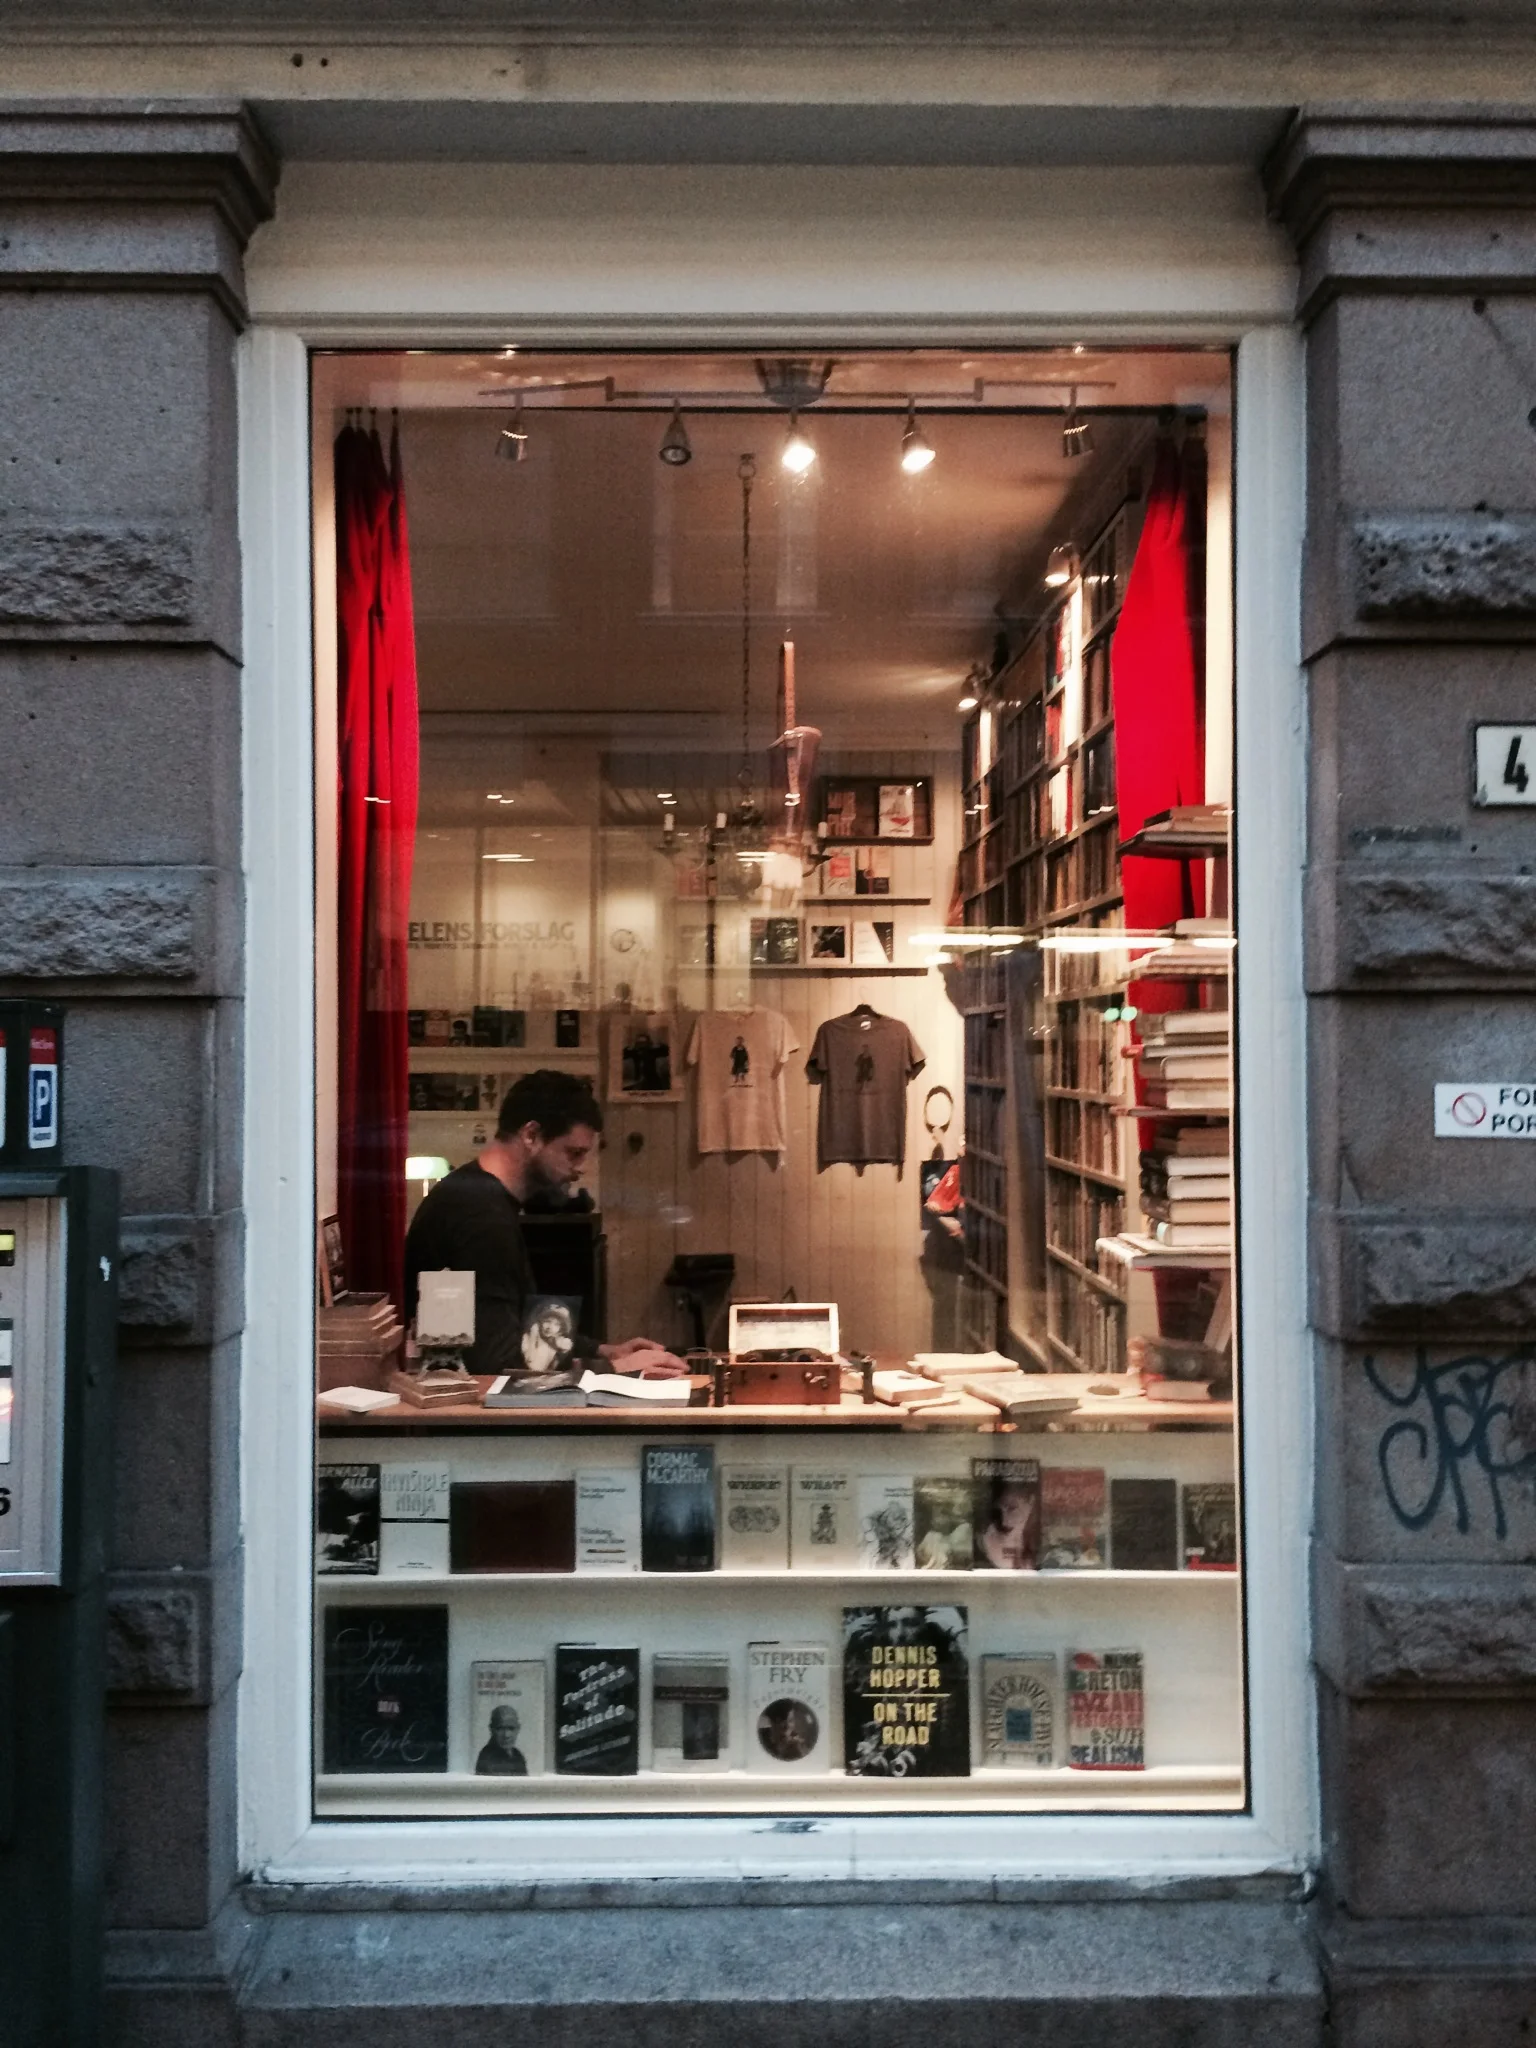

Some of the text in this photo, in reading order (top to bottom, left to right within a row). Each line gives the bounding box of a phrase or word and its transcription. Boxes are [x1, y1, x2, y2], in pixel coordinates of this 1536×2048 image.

[1503, 734, 1529, 794] 4
[408, 921, 575, 941] ELENS FORSLAG
[36, 1078, 50, 1121] P
[1499, 1087, 1536, 1107] FO
[646, 1452, 698, 1468] CORMAC
[319, 1466, 369, 1478] ORNADO
[381, 1470, 448, 1492] INVISIBLE
[396, 1493, 436, 1516] NINJA
[750, 1651, 826, 1666] STEPHEN
[871, 1645, 938, 1665] DENNIS
[769, 1667, 808, 1683] FRY
[869, 1668, 941, 1688] HOPPER
[873, 1702, 938, 1723] ON THE
[882, 1725, 930, 1745] ROAD
